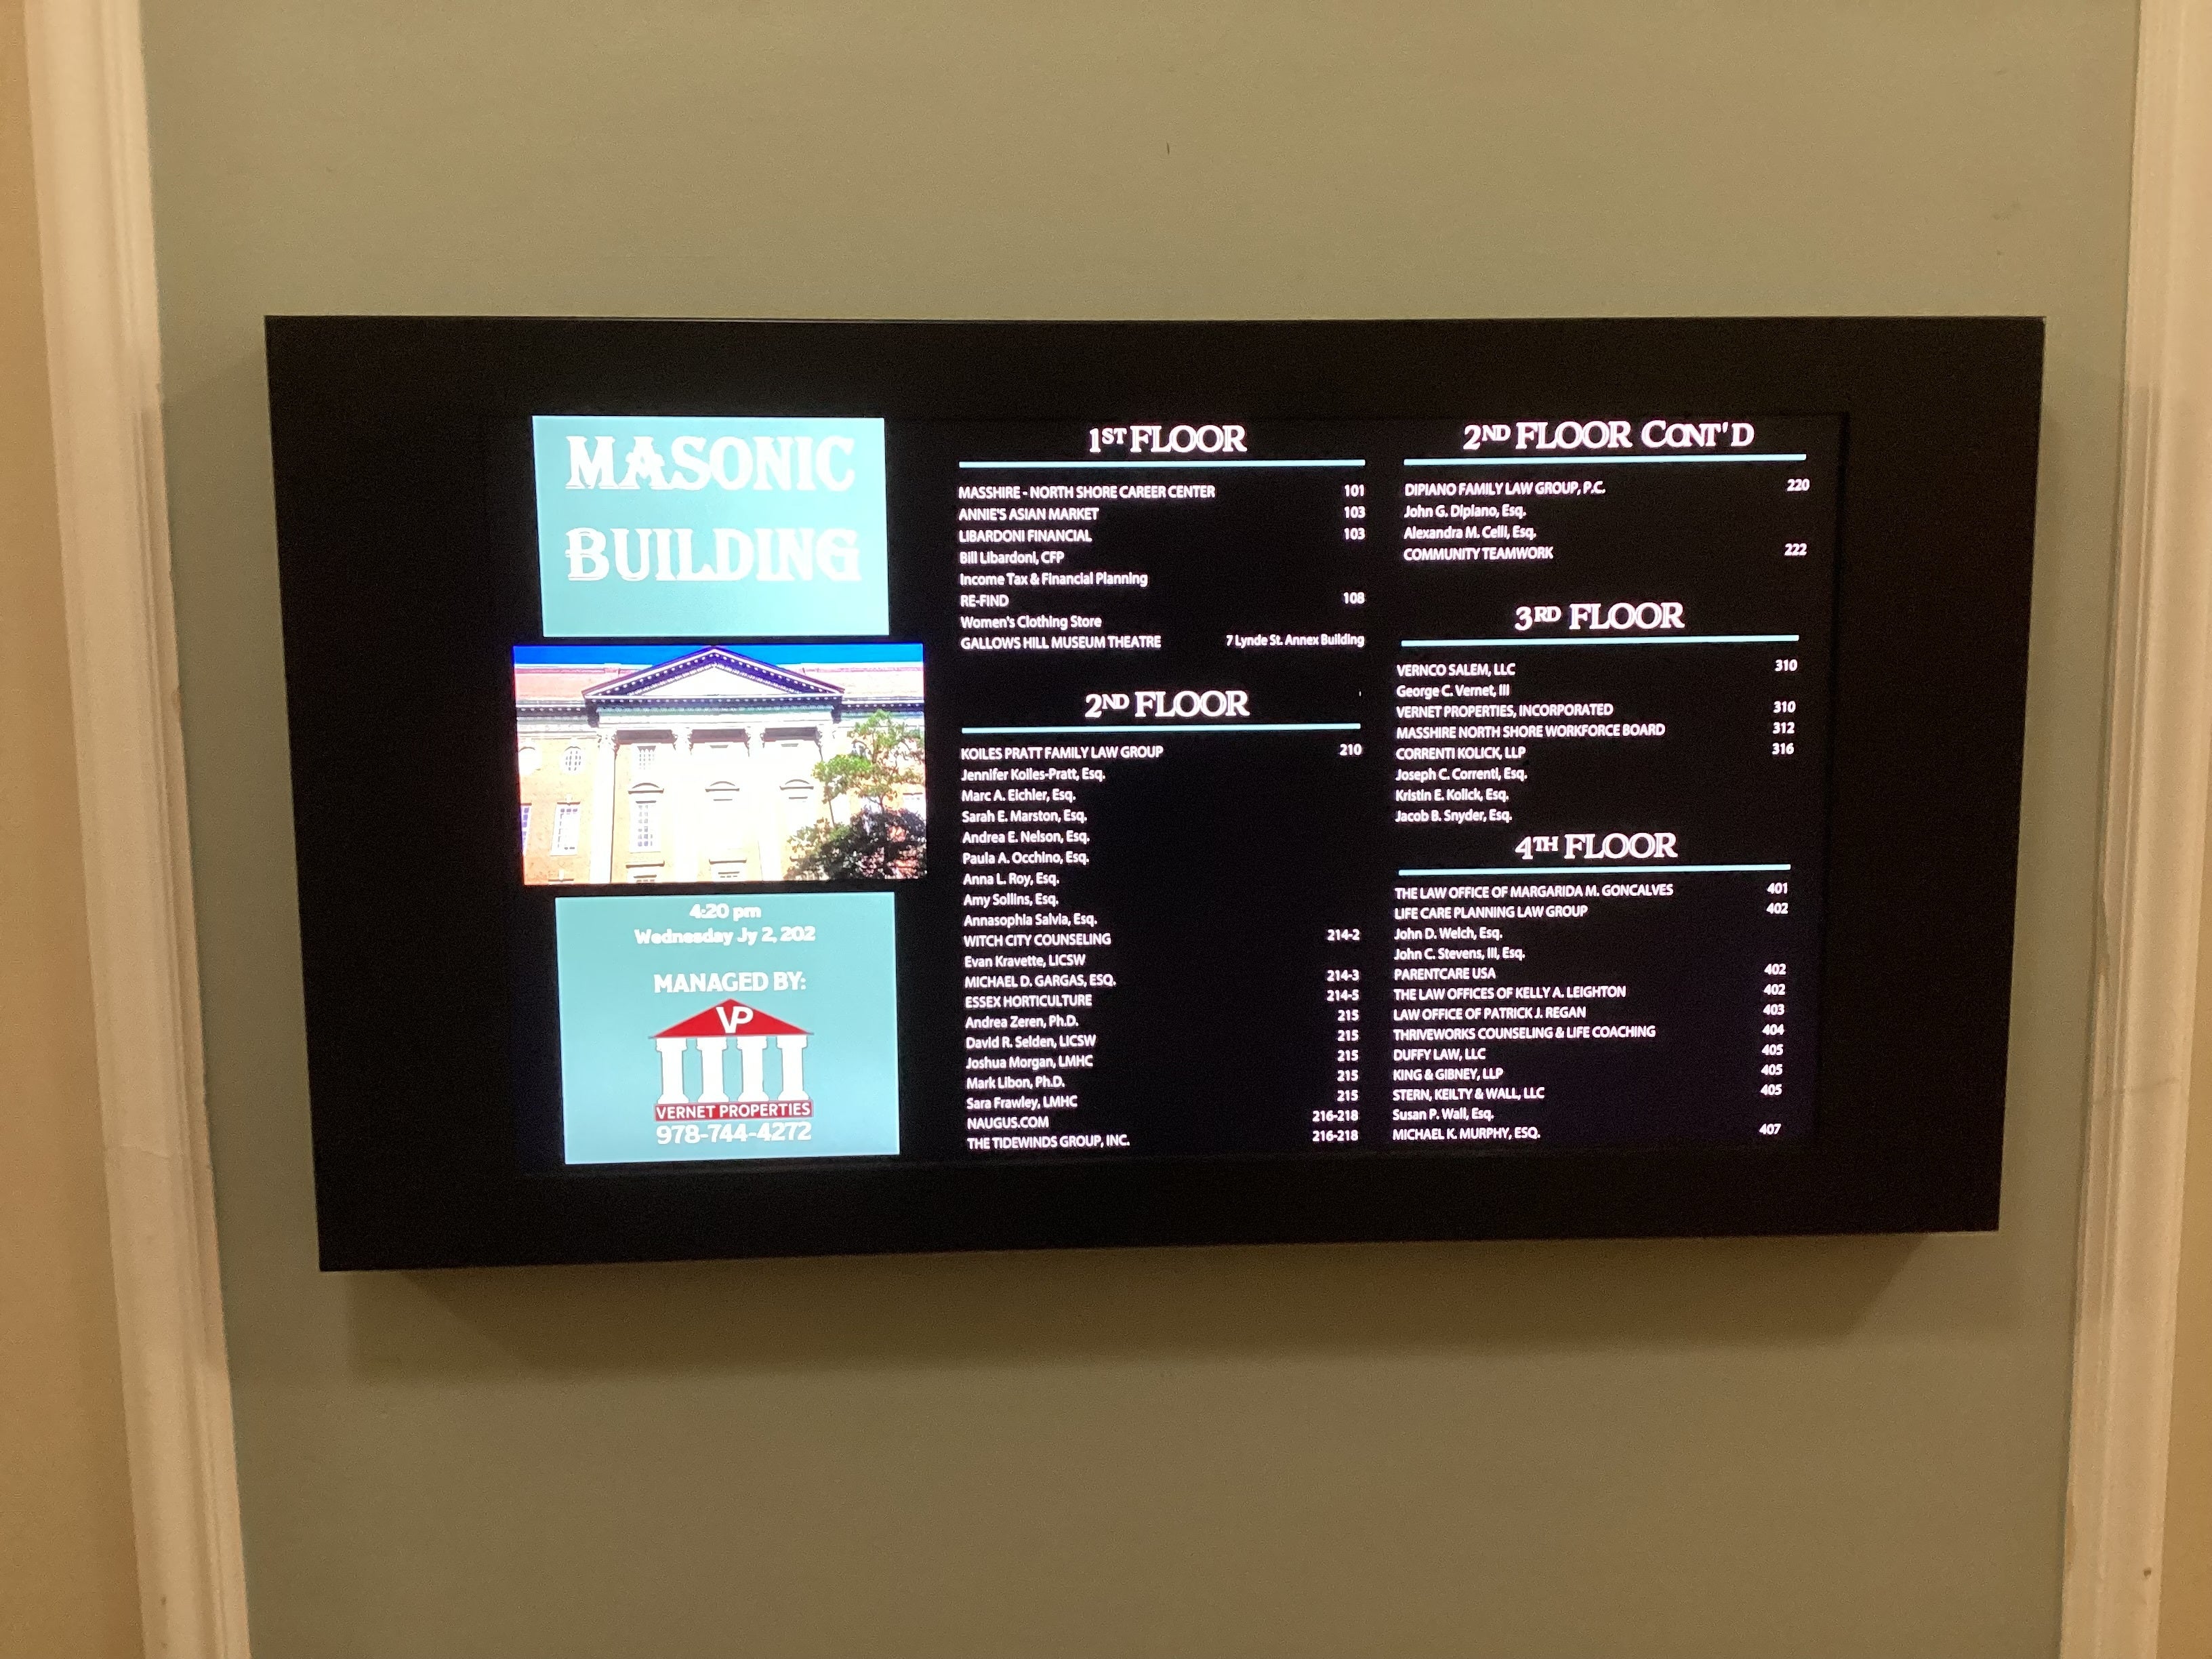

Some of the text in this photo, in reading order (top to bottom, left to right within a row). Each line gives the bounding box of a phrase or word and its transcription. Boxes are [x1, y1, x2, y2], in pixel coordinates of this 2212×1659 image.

[1090, 425, 1247, 453] 1ST FLOOR
[1463, 425, 1511, 450] 2ND
[1515, 421, 1633, 449] FLOOR
[565, 435, 855, 492] MASONIC
[1345, 485, 1364, 497] 101
[1405, 481, 1605, 496] DIPIANO FAMILY LAW GROUP, P.C.
[1787, 478, 1809, 491] 220
[959, 508, 1099, 520] ANNIE'S ASIAN MARKET
[1345, 506, 1366, 518] 103
[959, 529, 1092, 542] LIBARDONI FINANCIAL
[1345, 528, 1365, 539] 103
[565, 527, 861, 581] BUILDING
[1404, 546, 1553, 560] COMMUNITY TEAMWORK
[1784, 544, 1807, 556] 222
[960, 550, 1065, 565] Bill Libardoni, CFP
[960, 594, 1009, 607] RE-FIND
[1344, 592, 1365, 604] 108
[960, 615, 1102, 630] Women's Clothing Store
[1515, 602, 1685, 630] 3RD FLOOR
[961, 636, 1161, 649] GALLOWS HILL MUSEUM THEATRE
[1227, 633, 1364, 649] 7 Lynde St. Annex Building
[1397, 663, 1515, 677] VERNCO SALEM, LLC
[1775, 659, 1797, 672] 310
[1085, 691, 1250, 718] 2ND FLOOR
[1396, 703, 1614, 718] VERNET PROPERTIES, INCORPORATED
[1774, 701, 1796, 713] 310
[1397, 723, 1665, 739] MASSHIRE NORTH SHORE WORKFORCE BOARD
[1773, 722, 1795, 734] 312
[961, 745, 1164, 760] KOILES PRATT FAMILY LAW GROUP
[1340, 743, 1362, 756] 210
[1395, 746, 1526, 760] CORRENTI KOLICK, LLP
[1772, 743, 1794, 754] 316
[961, 768, 1008, 781] Jennifer
[1082, 767, 1105, 782] Esq.
[1515, 832, 1678, 859] 4TH FLOOR
[1395, 884, 1673, 899] THE LAW OFFICE OF MARGARIDA M. GONCALVES
[1767, 882, 1787, 894] 401
[689, 903, 761, 922] 4:20 pm
[1395, 905, 1588, 920] LIFE CARE PLANNING LAW GROUP
[1766, 903, 1788, 914] 402
[634, 928, 733, 946] Wednesday
[761, 928, 777, 943] 2,
[781, 926, 815, 941] 202
[964, 933, 1111, 947] WITCH CITY COUNSELING
[1328, 929, 1359, 941] 214-2
[964, 954, 1086, 968] Evan Kravette, LICSW
[1327, 969, 1359, 981] 214-3
[1394, 967, 1496, 981] PARENTCARE USA
[1764, 964, 1786, 975] 402
[654, 971, 806, 993] MANAGED BY:
[1327, 989, 1359, 1002] 214-5
[1764, 984, 1785, 995] 402
[966, 994, 1092, 1008] ESSEX HORTICULTURE
[1338, 1009, 1359, 1021] 215
[1393, 1006, 1586, 1021] LAW OFFICE OF PATRICK J. REGAN
[1763, 1004, 1784, 1015] 403
[716, 1006, 754, 1033] VP
[1338, 1029, 1359, 1042] 215
[1393, 1025, 1656, 1041] THRIVEWORKS COUNSELING & LIFE COACHING
[1762, 1024, 1784, 1035] 404
[1338, 1050, 1358, 1061] 215
[1393, 1048, 1486, 1061] DUFFY LAW, LLC
[1762, 1044, 1783, 1055] 405
[966, 1054, 1093, 1070] Joshua Morgan, LMHC
[1337, 1069, 1358, 1082] 215
[1761, 1064, 1782, 1076] 405
[1337, 1090, 1358, 1101] 215
[1761, 1084, 1782, 1095] 405
[656, 1103, 811, 1120] VERNET PROPERTIES
[1313, 1110, 1358, 1122] 216-218
[967, 1116, 1049, 1130] NAUGUS.COM
[1759, 1124, 1781, 1134] 407
[656, 1122, 811, 1145] 978-744-4272
[1313, 1130, 1358, 1141] 216-218
[967, 1134, 1130, 1149] THE TIDEWINDS GROUP, INC.
